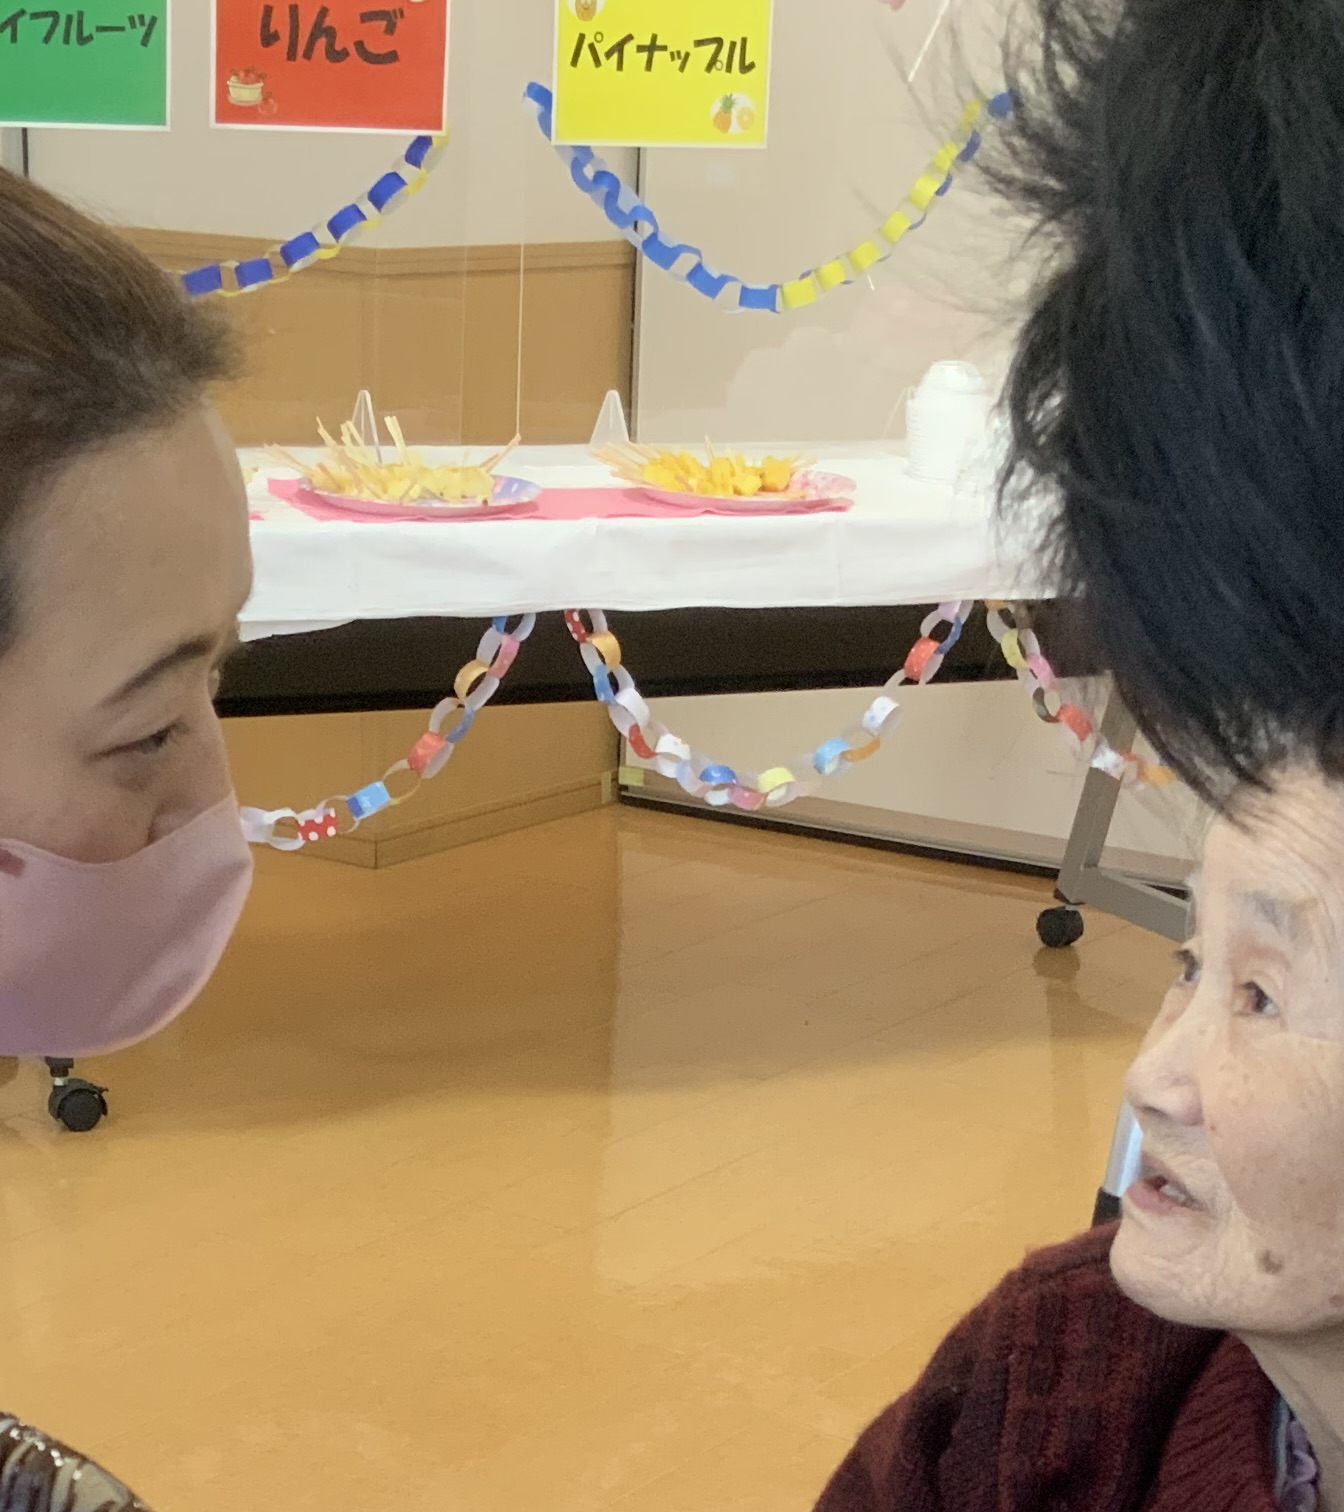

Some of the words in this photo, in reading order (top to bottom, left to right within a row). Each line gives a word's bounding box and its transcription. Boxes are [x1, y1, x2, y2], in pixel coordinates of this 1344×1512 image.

[260, 4, 404, 65] りんご
[570, 31, 756, 75] パイナップル
